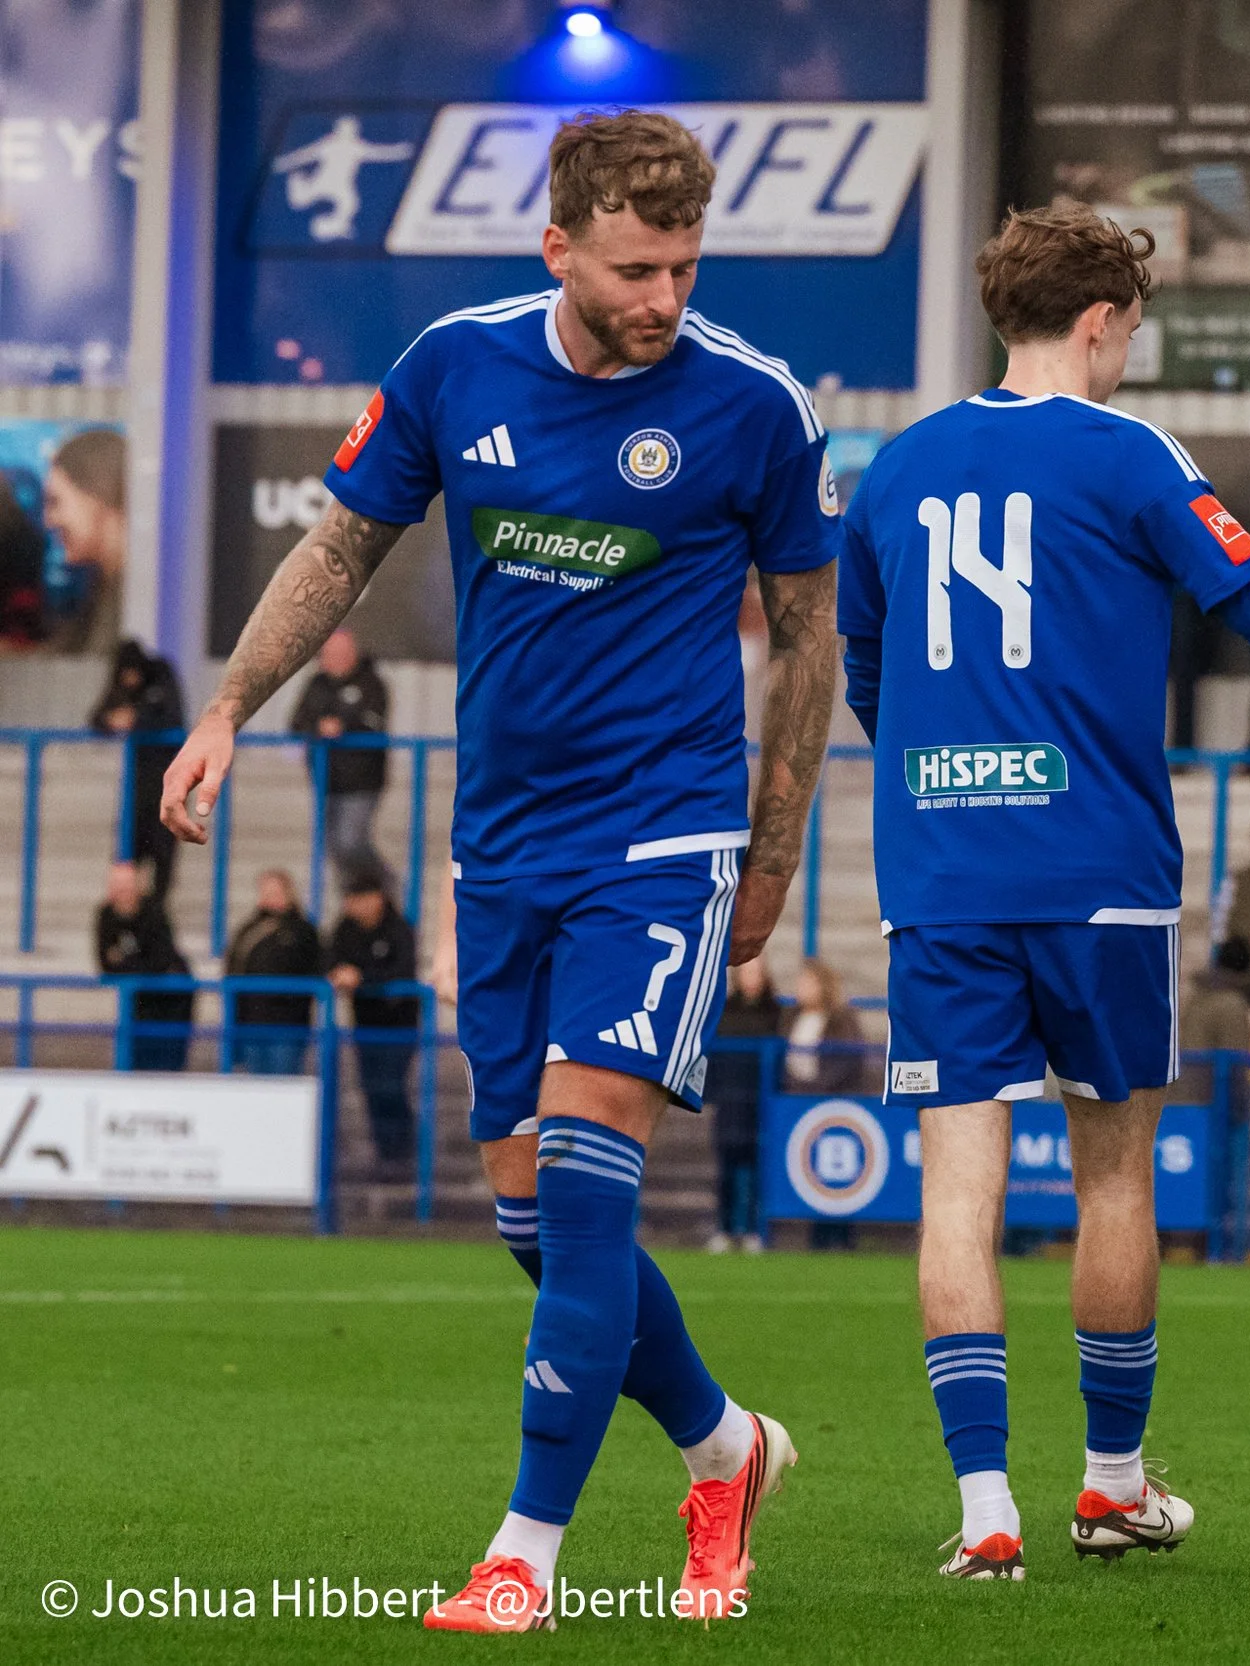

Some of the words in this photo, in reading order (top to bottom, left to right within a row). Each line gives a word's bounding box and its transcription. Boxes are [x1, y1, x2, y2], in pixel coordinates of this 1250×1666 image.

[493, 521, 627, 567] Pinnacle
[497, 559, 556, 584] Electrical
[917, 491, 1033, 671] 14
[919, 748, 1048, 794] HiSPEC
[968, 796, 1003, 808] HOUSING
[1004, 795, 1050, 807] SOLUTIONS
[647, 922, 687, 1012] 7
